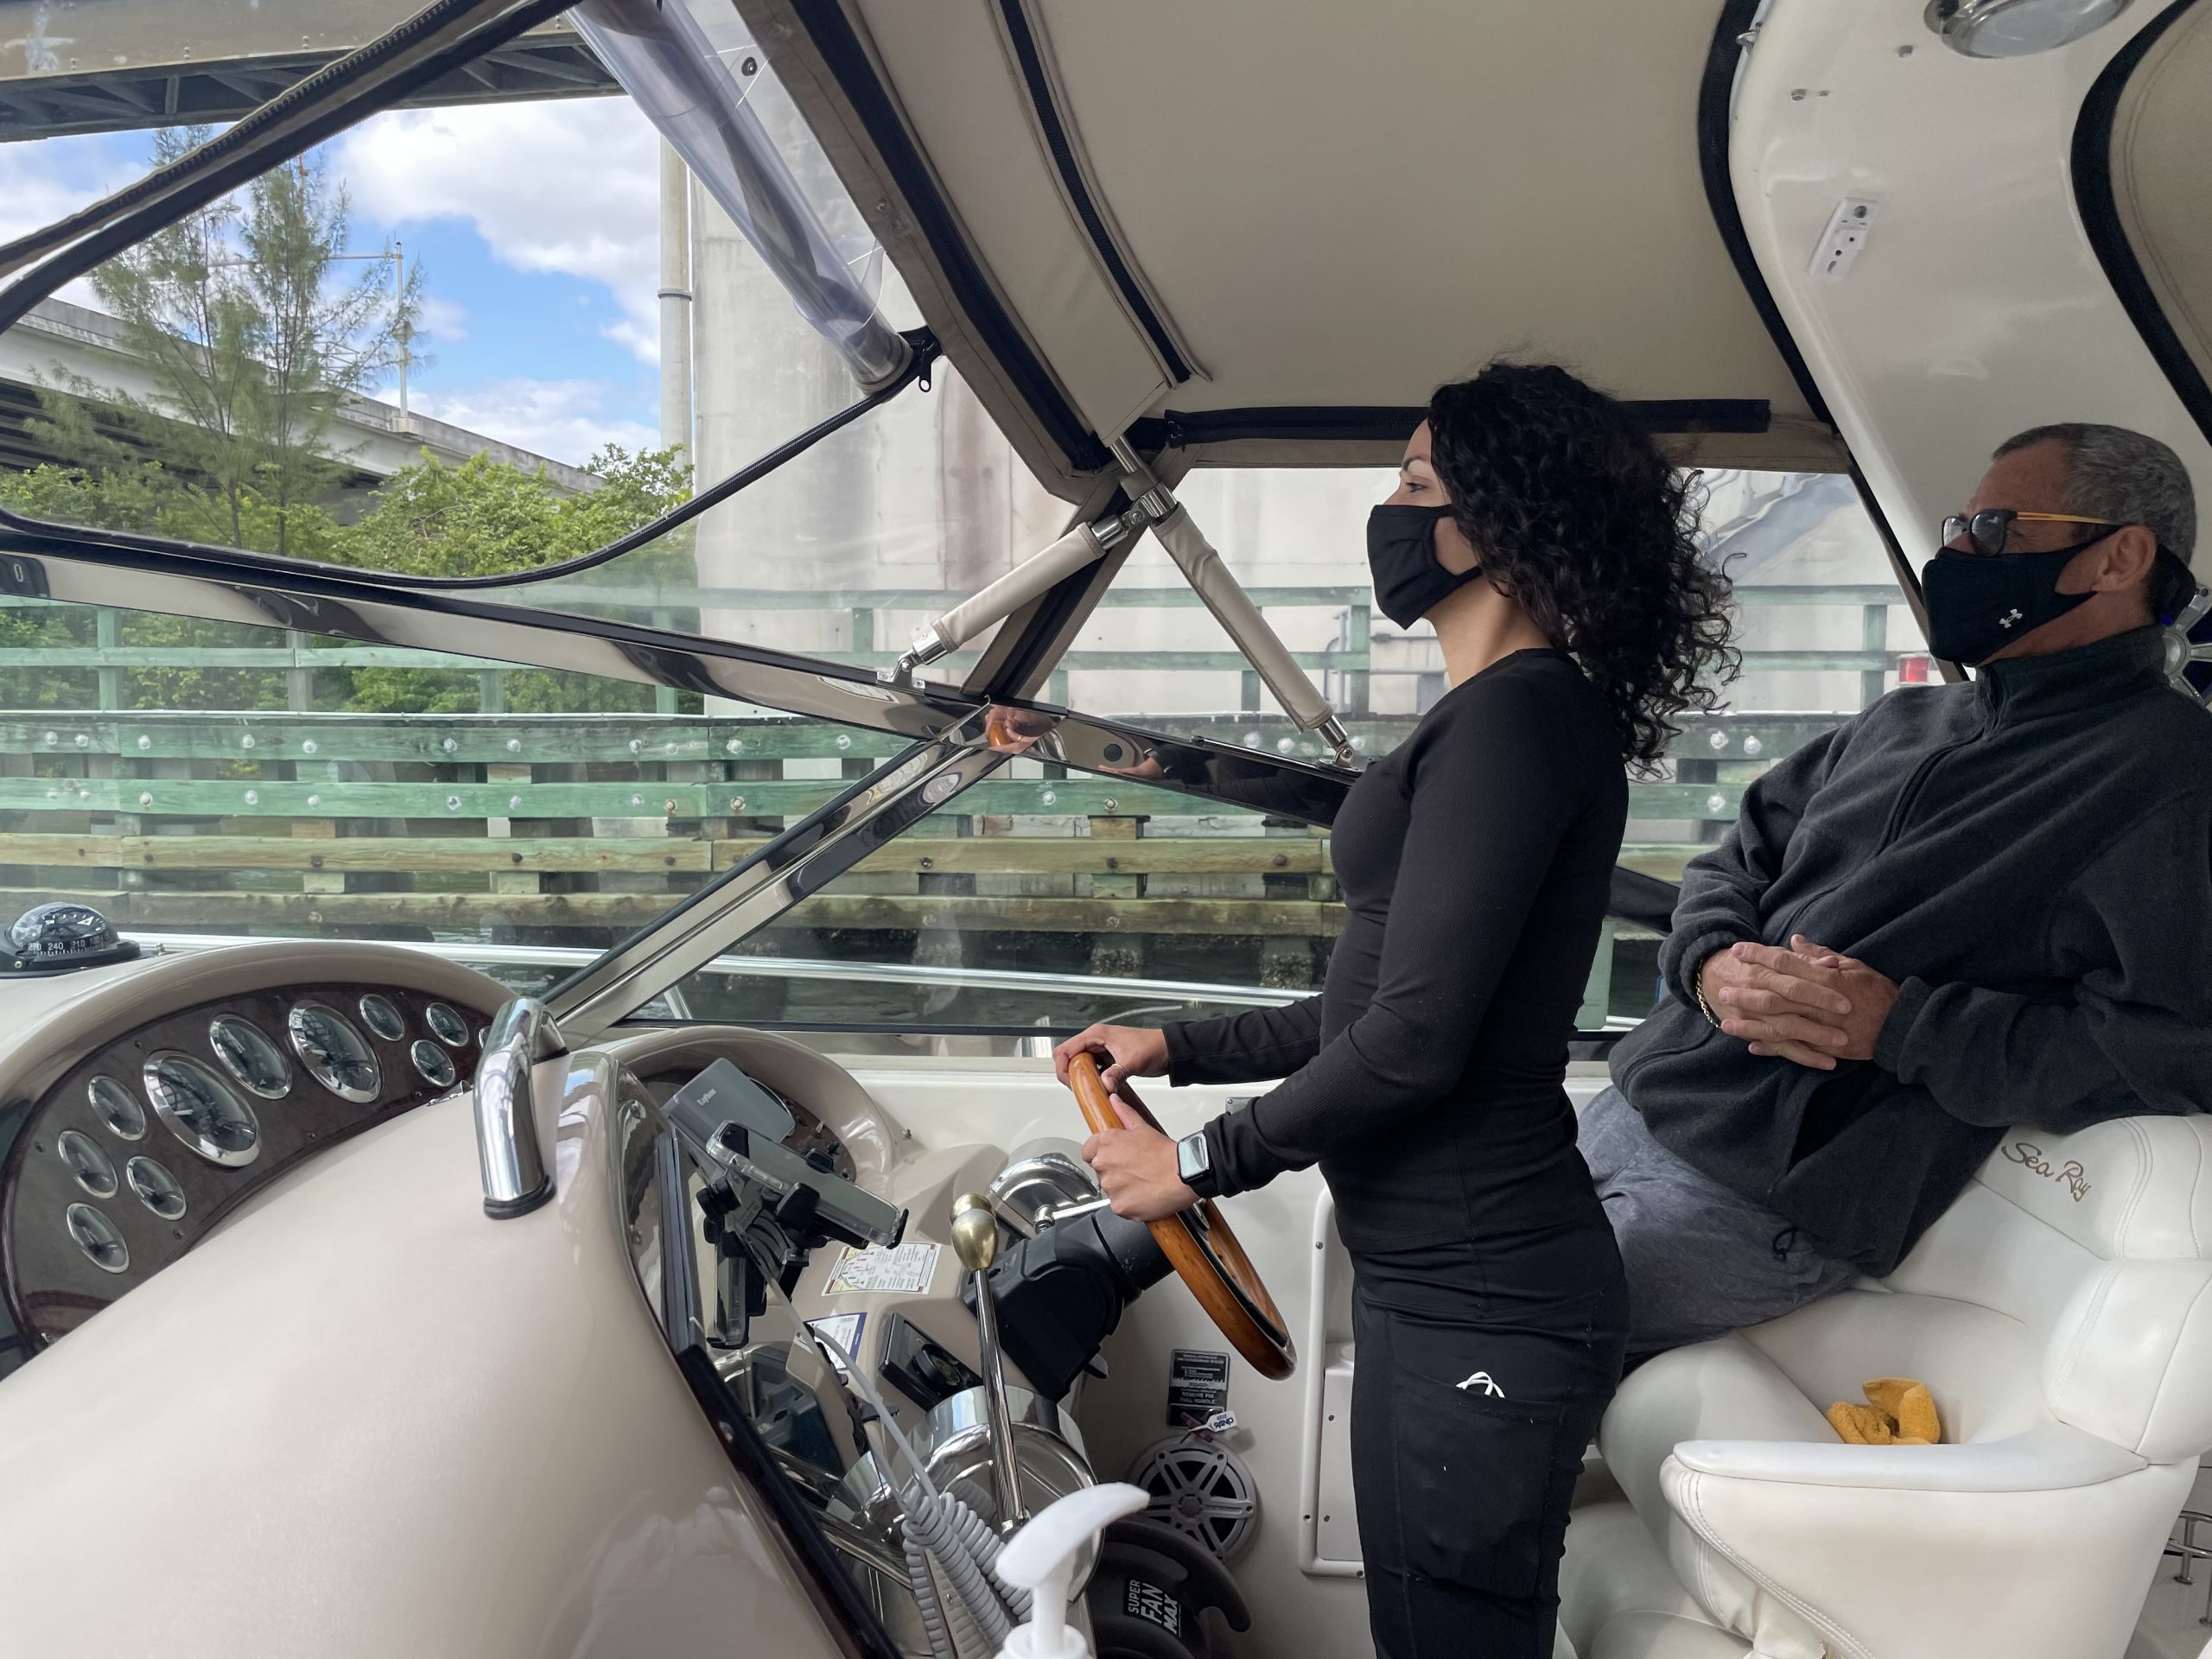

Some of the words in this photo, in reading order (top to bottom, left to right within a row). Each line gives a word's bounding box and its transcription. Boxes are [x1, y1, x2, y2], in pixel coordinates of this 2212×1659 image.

[28, 942, 42, 951] 270
[48, 942, 64, 950] 240
[2000, 1141, 2055, 1178] Sea
[2055, 1160, 2092, 1203] Ray
[1128, 1580, 1141, 1613] SUPER
[1141, 1582, 1163, 1624] FAN
[1163, 1592, 1178, 1635] MAX
